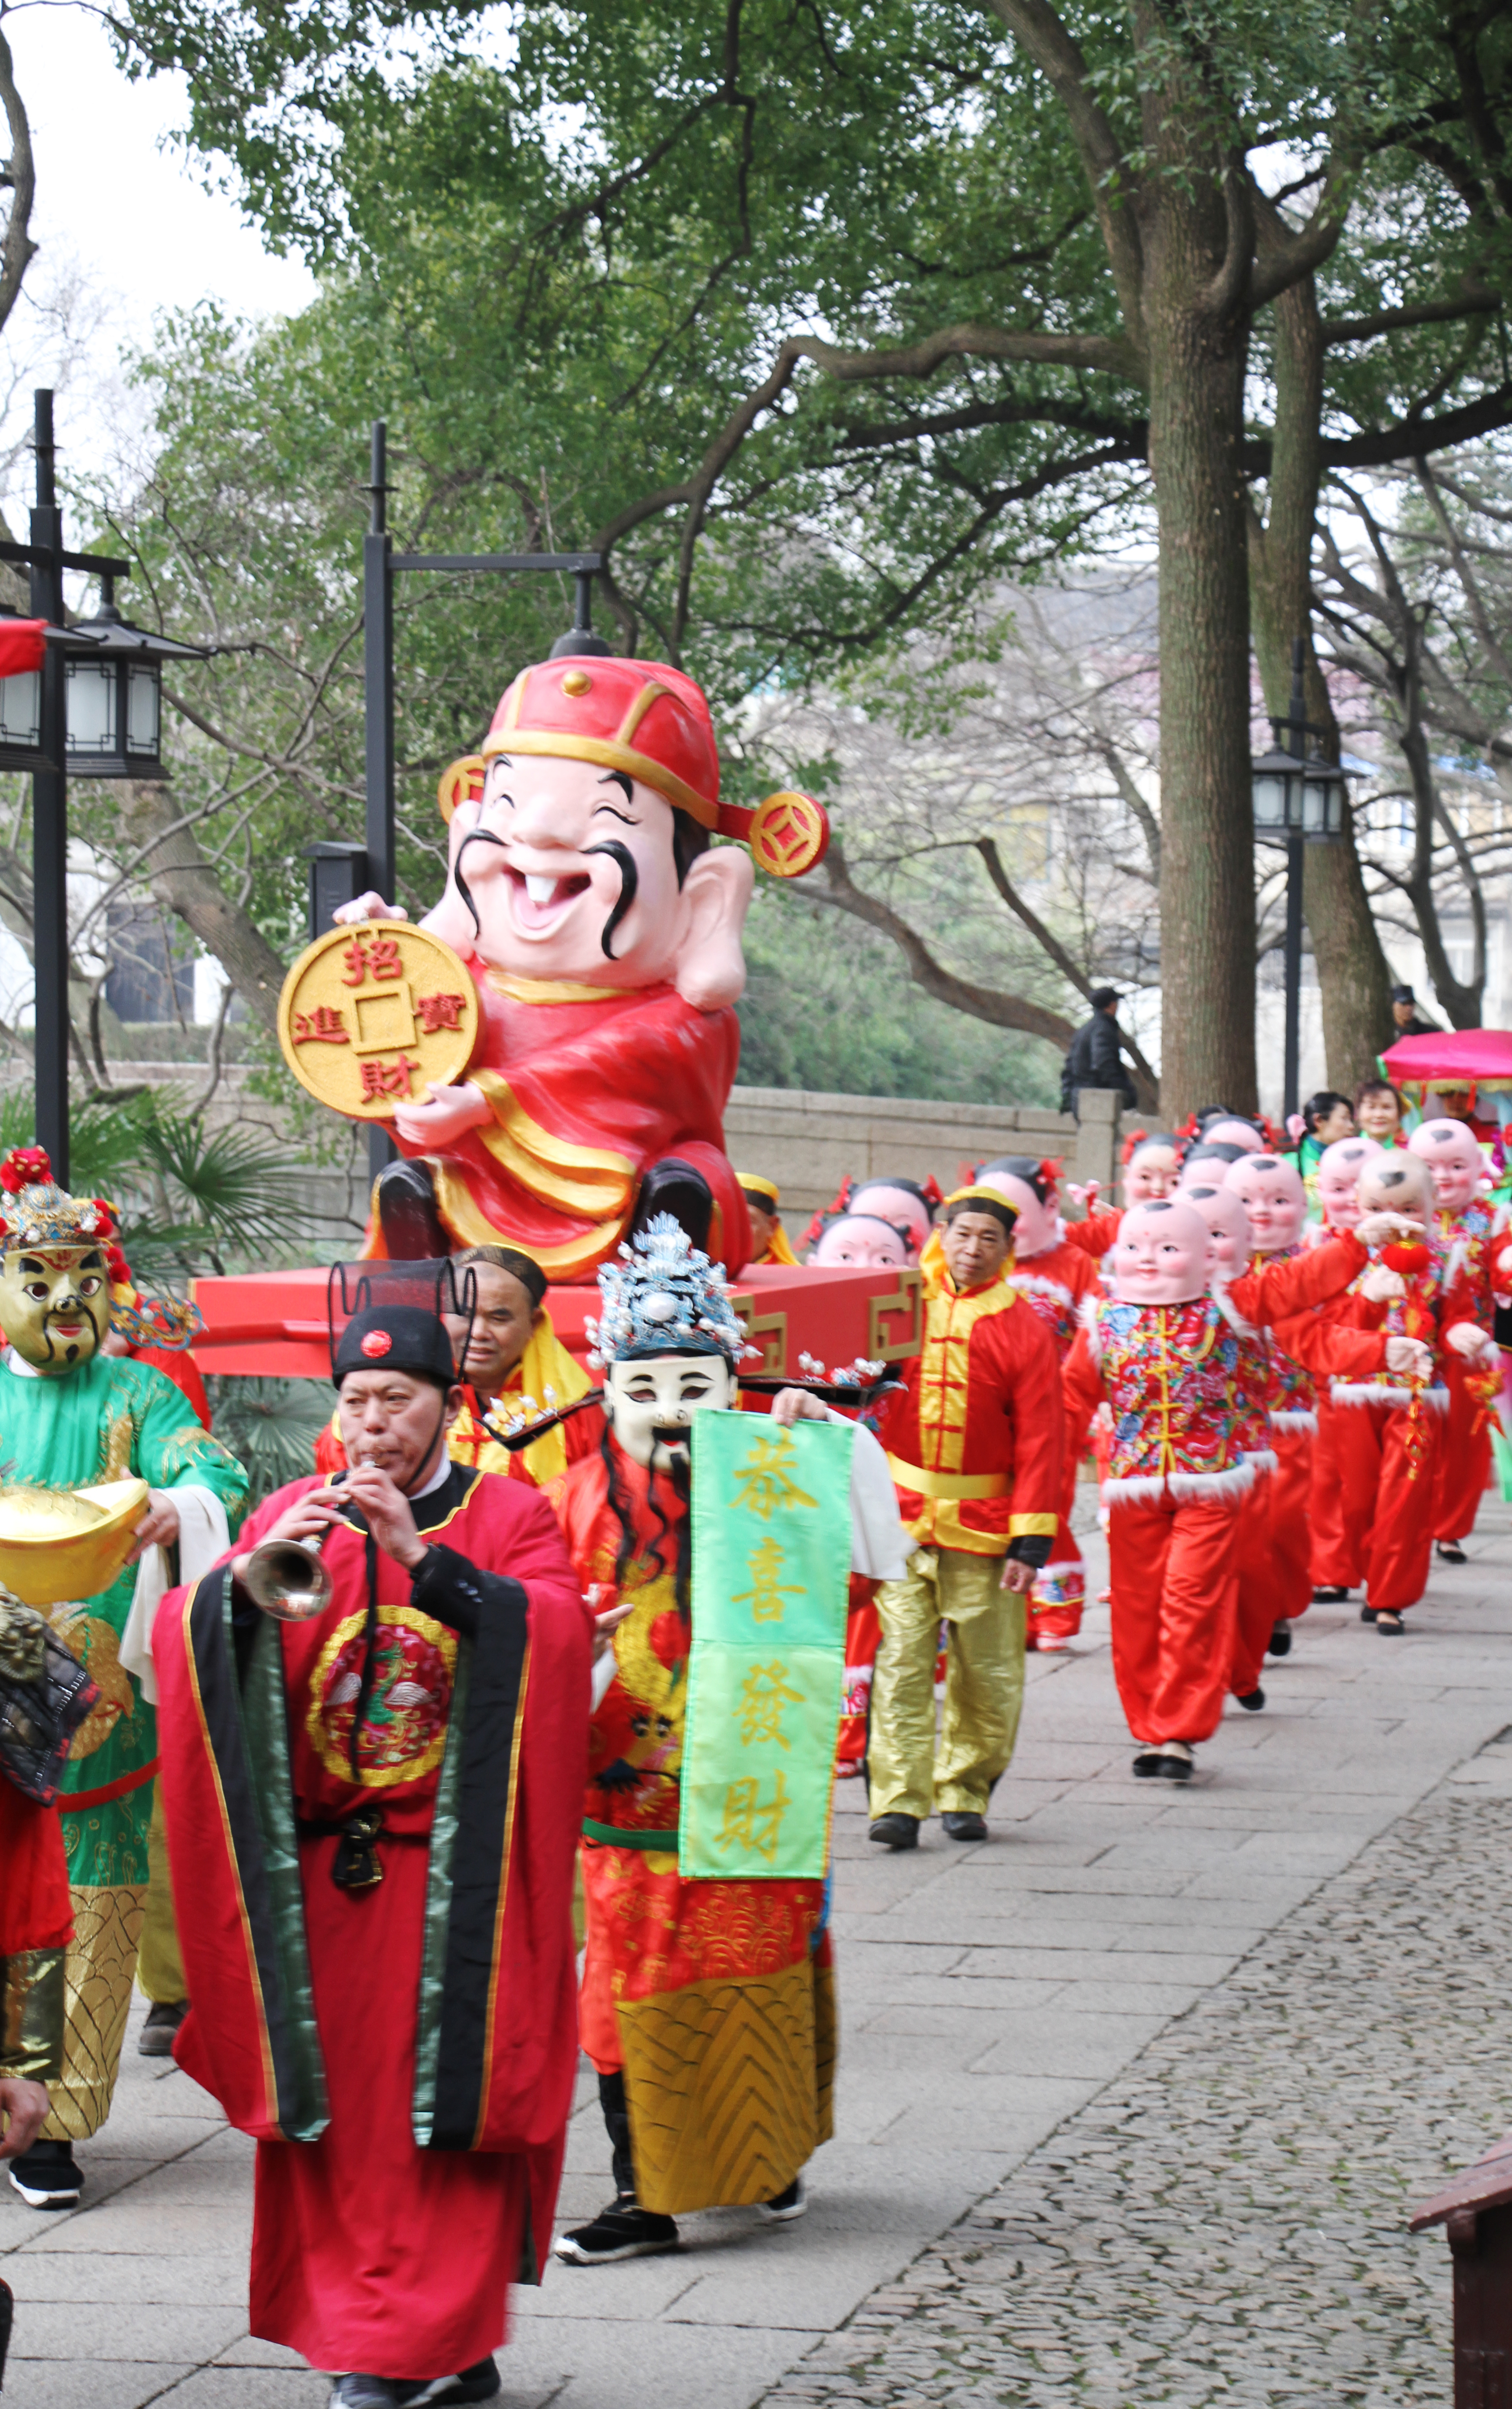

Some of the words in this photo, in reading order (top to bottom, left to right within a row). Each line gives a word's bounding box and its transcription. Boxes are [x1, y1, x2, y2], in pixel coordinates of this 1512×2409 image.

[342, 940, 402, 986] 招
[293, 1005, 349, 1045] 進
[360, 1053, 419, 1103] 財
[713, 1427, 819, 1863] 恭喜發財
